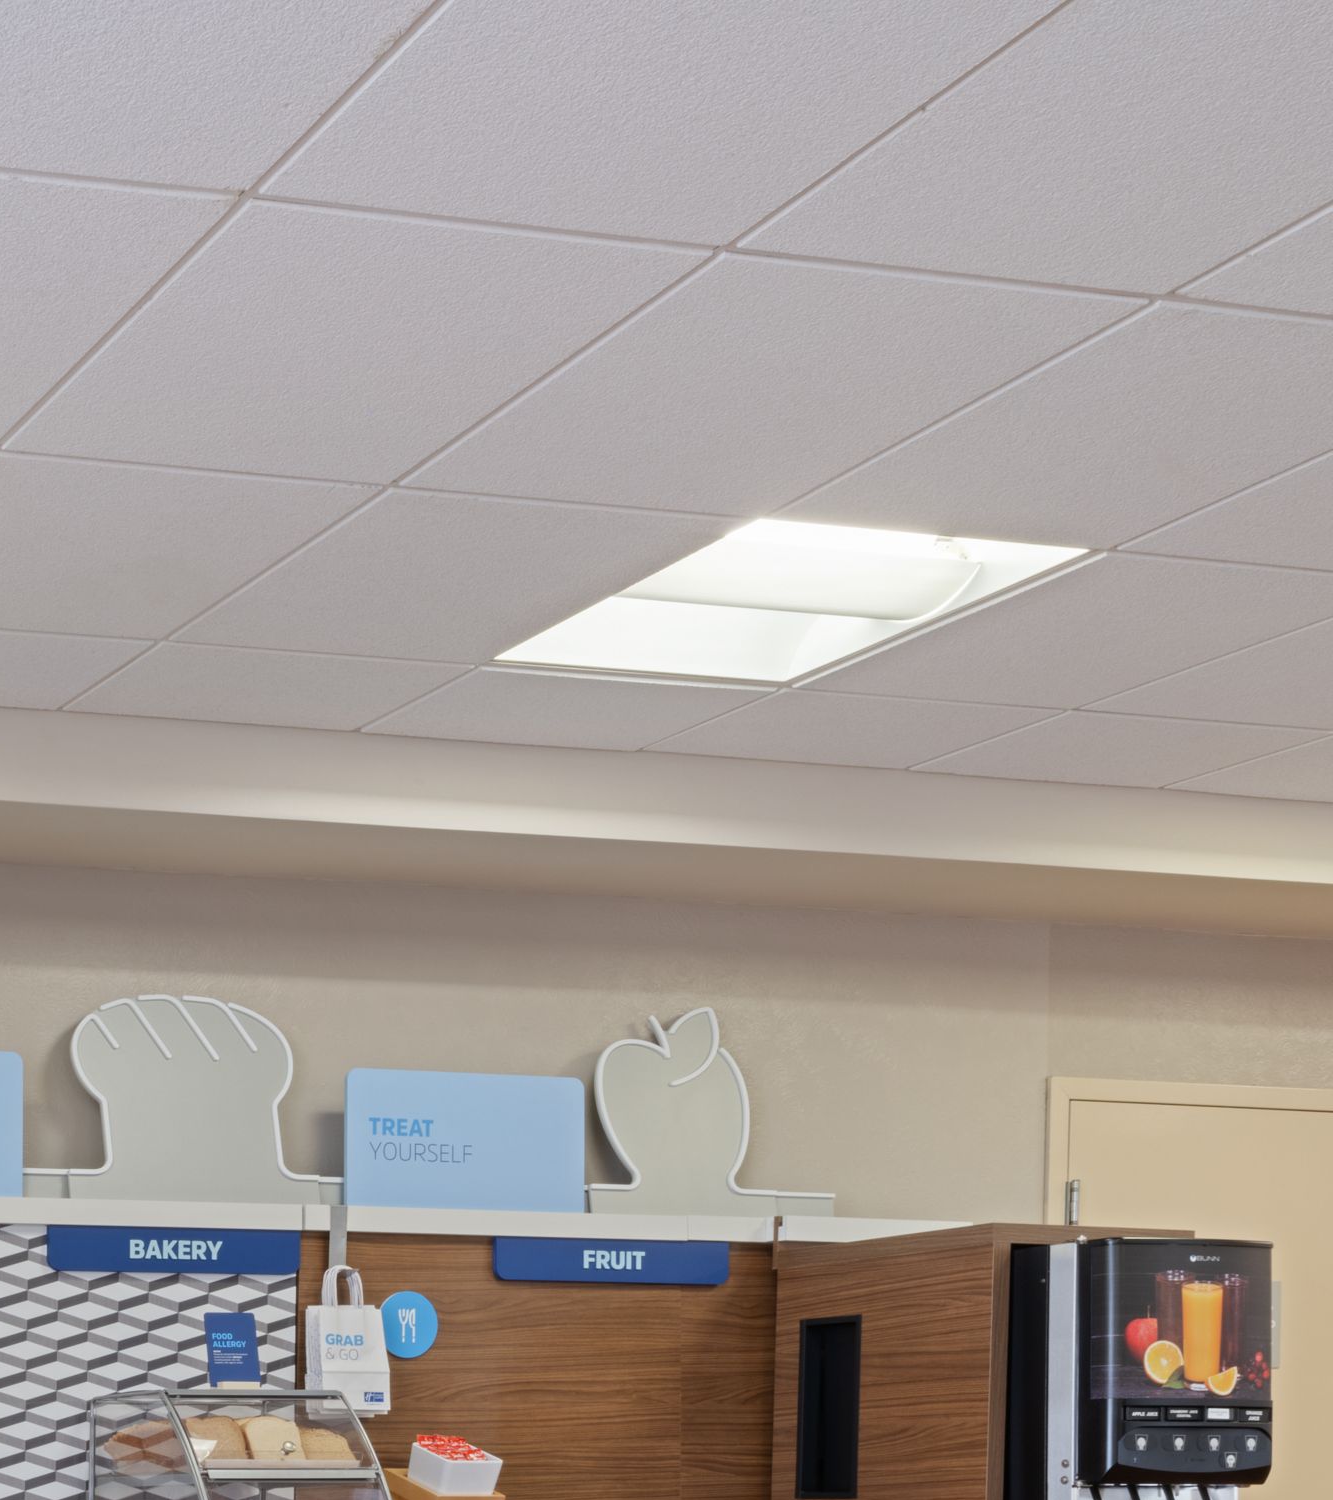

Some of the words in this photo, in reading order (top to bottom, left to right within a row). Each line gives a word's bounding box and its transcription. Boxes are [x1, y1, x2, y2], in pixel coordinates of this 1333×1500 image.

[368, 1117, 434, 1137] TREAT
[369, 1142, 473, 1163] YOURSELF
[129, 1239, 223, 1261] BAKERY
[583, 1249, 646, 1270] FRUIT
[212, 1332, 232, 1340] FOOD
[213, 1340, 246, 1348] ALLERGY
[326, 1333, 364, 1346] GRAB
[326, 1347, 334, 1360] &
[340, 1348, 358, 1361] GO
